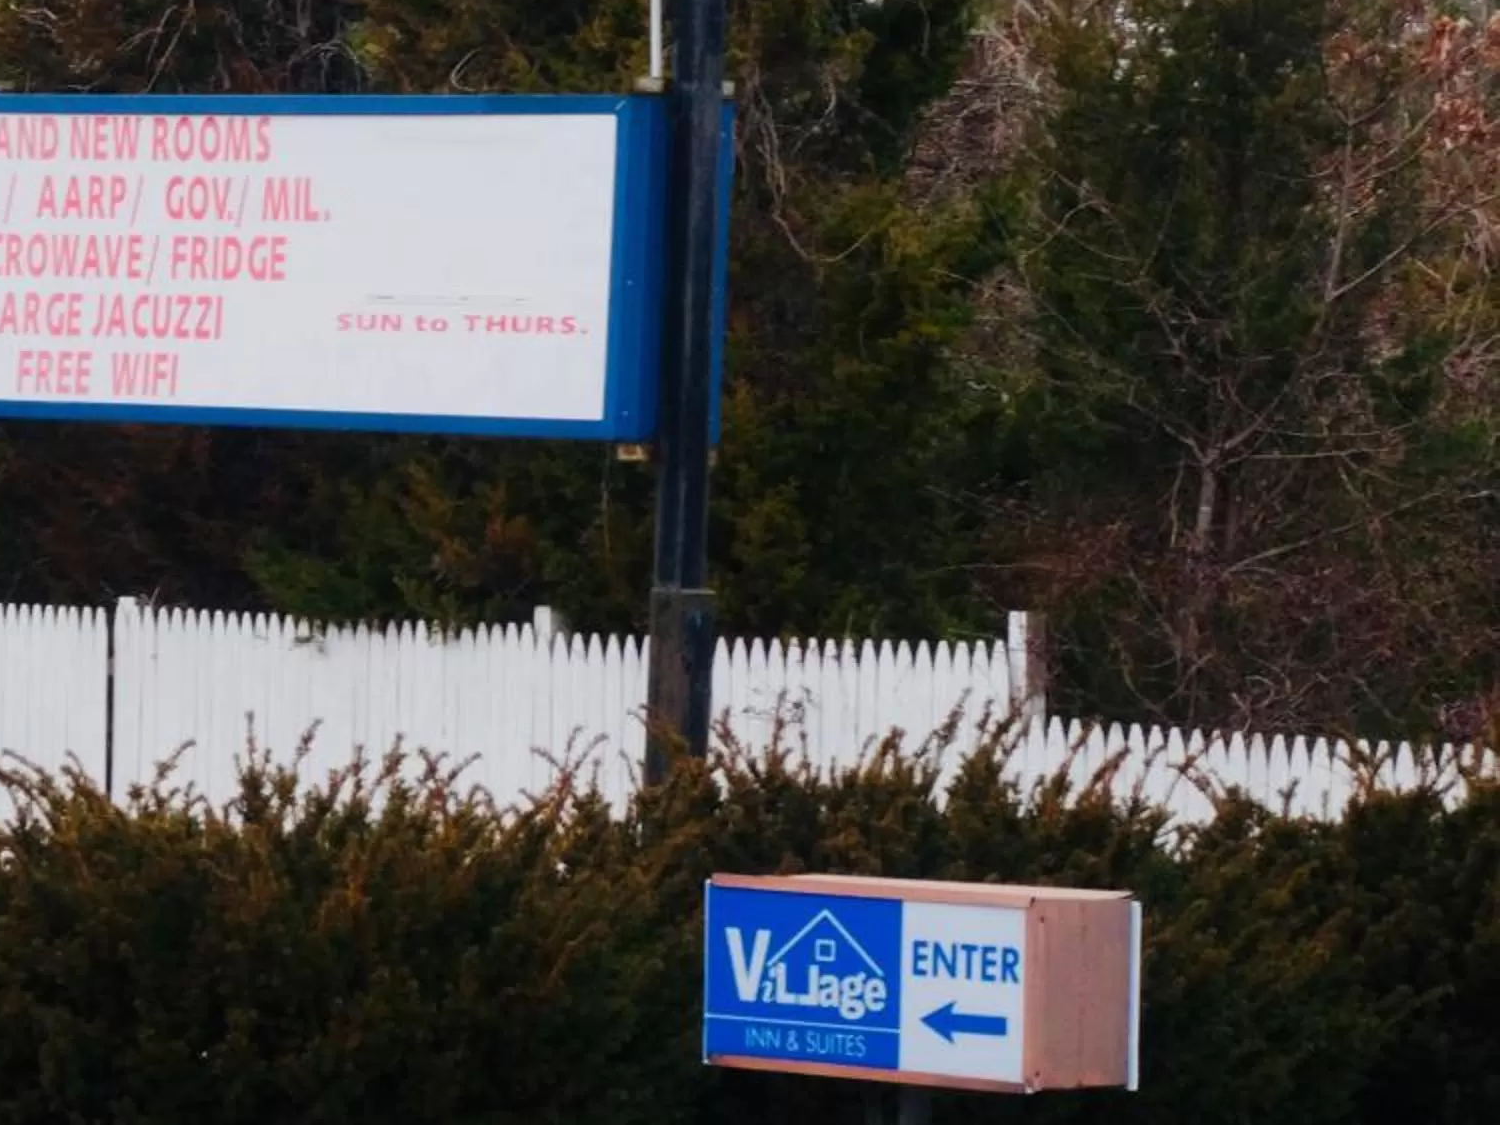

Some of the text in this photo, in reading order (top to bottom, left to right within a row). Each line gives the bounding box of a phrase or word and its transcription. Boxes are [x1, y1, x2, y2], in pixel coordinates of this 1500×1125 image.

[69, 115, 141, 161] NEW
[151, 115, 272, 162] ROOMS
[261, 176, 332, 222] MIL.
[170, 235, 288, 281] FRIDGE
[92, 293, 225, 340] JACUZZI
[336, 312, 590, 335] SUN to THURS.
[15, 349, 180, 396] FREE WIFI
[912, 939, 1020, 984] ENTER
[745, 1027, 868, 1057] INN & SUITES
